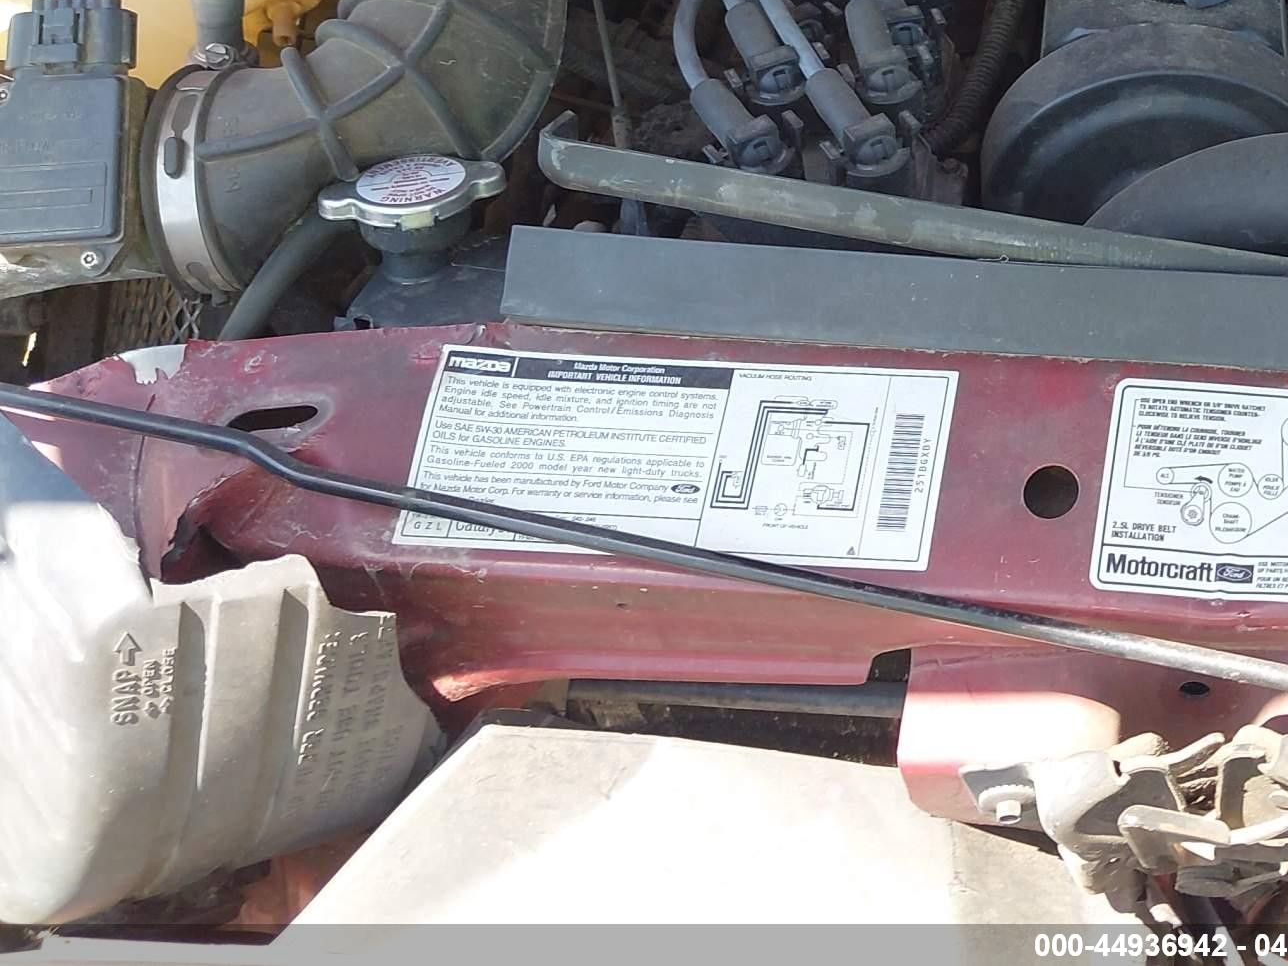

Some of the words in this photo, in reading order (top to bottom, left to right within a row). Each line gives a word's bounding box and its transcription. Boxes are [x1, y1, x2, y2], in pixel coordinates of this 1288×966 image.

[448, 356, 511, 372] mazda
[573, 362, 598, 370] Mazda
[598, 363, 621, 371] Motor
[620, 364, 665, 375] Corporation
[444, 375, 466, 386] This
[468, 378, 500, 388] vehicle
[511, 383, 552, 392] equipped
[573, 385, 615, 395] electronic
[616, 388, 646, 397] engine
[648, 390, 678, 398] control
[547, 370, 592, 379] IMPORTANT
[595, 372, 627, 381] VEHICLE
[627, 374, 681, 384] INFORMATION
[443, 385, 477, 396] Engine
[595, 396, 612, 404] and
[615, 396, 648, 407] ignition
[651, 400, 681, 409] timing
[438, 405, 472, 414] Manual
[473, 407, 487, 416] for
[486, 409, 529, 419] additional
[498, 398, 518, 408] See
[522, 399, 572, 412] Powertrain
[668, 408, 714, 420] Diagnosis
[431, 430, 456, 440] OILS
[457, 433, 470, 441] for
[471, 434, 520, 445] GASOLINE
[434, 421, 453, 429] Use
[453, 422, 474, 431] SAE
[474, 425, 503, 433] 5W-30
[503, 426, 551, 436] AMERICAN
[552, 429, 609, 439] PETROLEUM
[610, 432, 657, 442] INSTITUTE
[658, 434, 706, 444] CERTIFIED
[428, 444, 450, 454] This
[452, 446, 487, 457] vehicle
[489, 447, 531, 459] conforms
[569, 453, 589, 462] EPA
[592, 455, 642, 465] regulations
[645, 457, 692, 468] applicable
[509, 460, 534, 469] 2000
[538, 462, 567, 471] model
[571, 465, 592, 473] year
[597, 463, 616, 473] new
[421, 470, 442, 480] This
[442, 473, 472, 481] vehicle
[490, 475, 512, 483] been
[512, 476, 569, 486] manufactured
[569, 479, 581, 488] by
[582, 479, 602, 487] Ford
[603, 480, 628, 489] Motor
[628, 481, 669, 492] Company
[413, 520, 421, 528] G
[424, 521, 433, 529] Z
[1132, 522, 1154, 531] DRIVE
[1157, 524, 1176, 533] BELT
[1111, 530, 1164, 541] INSTALLATION
[1105, 552, 1212, 581] Motorcraft
[141, 659, 160, 698] OPEN
[111, 668, 141, 725] SNAP
